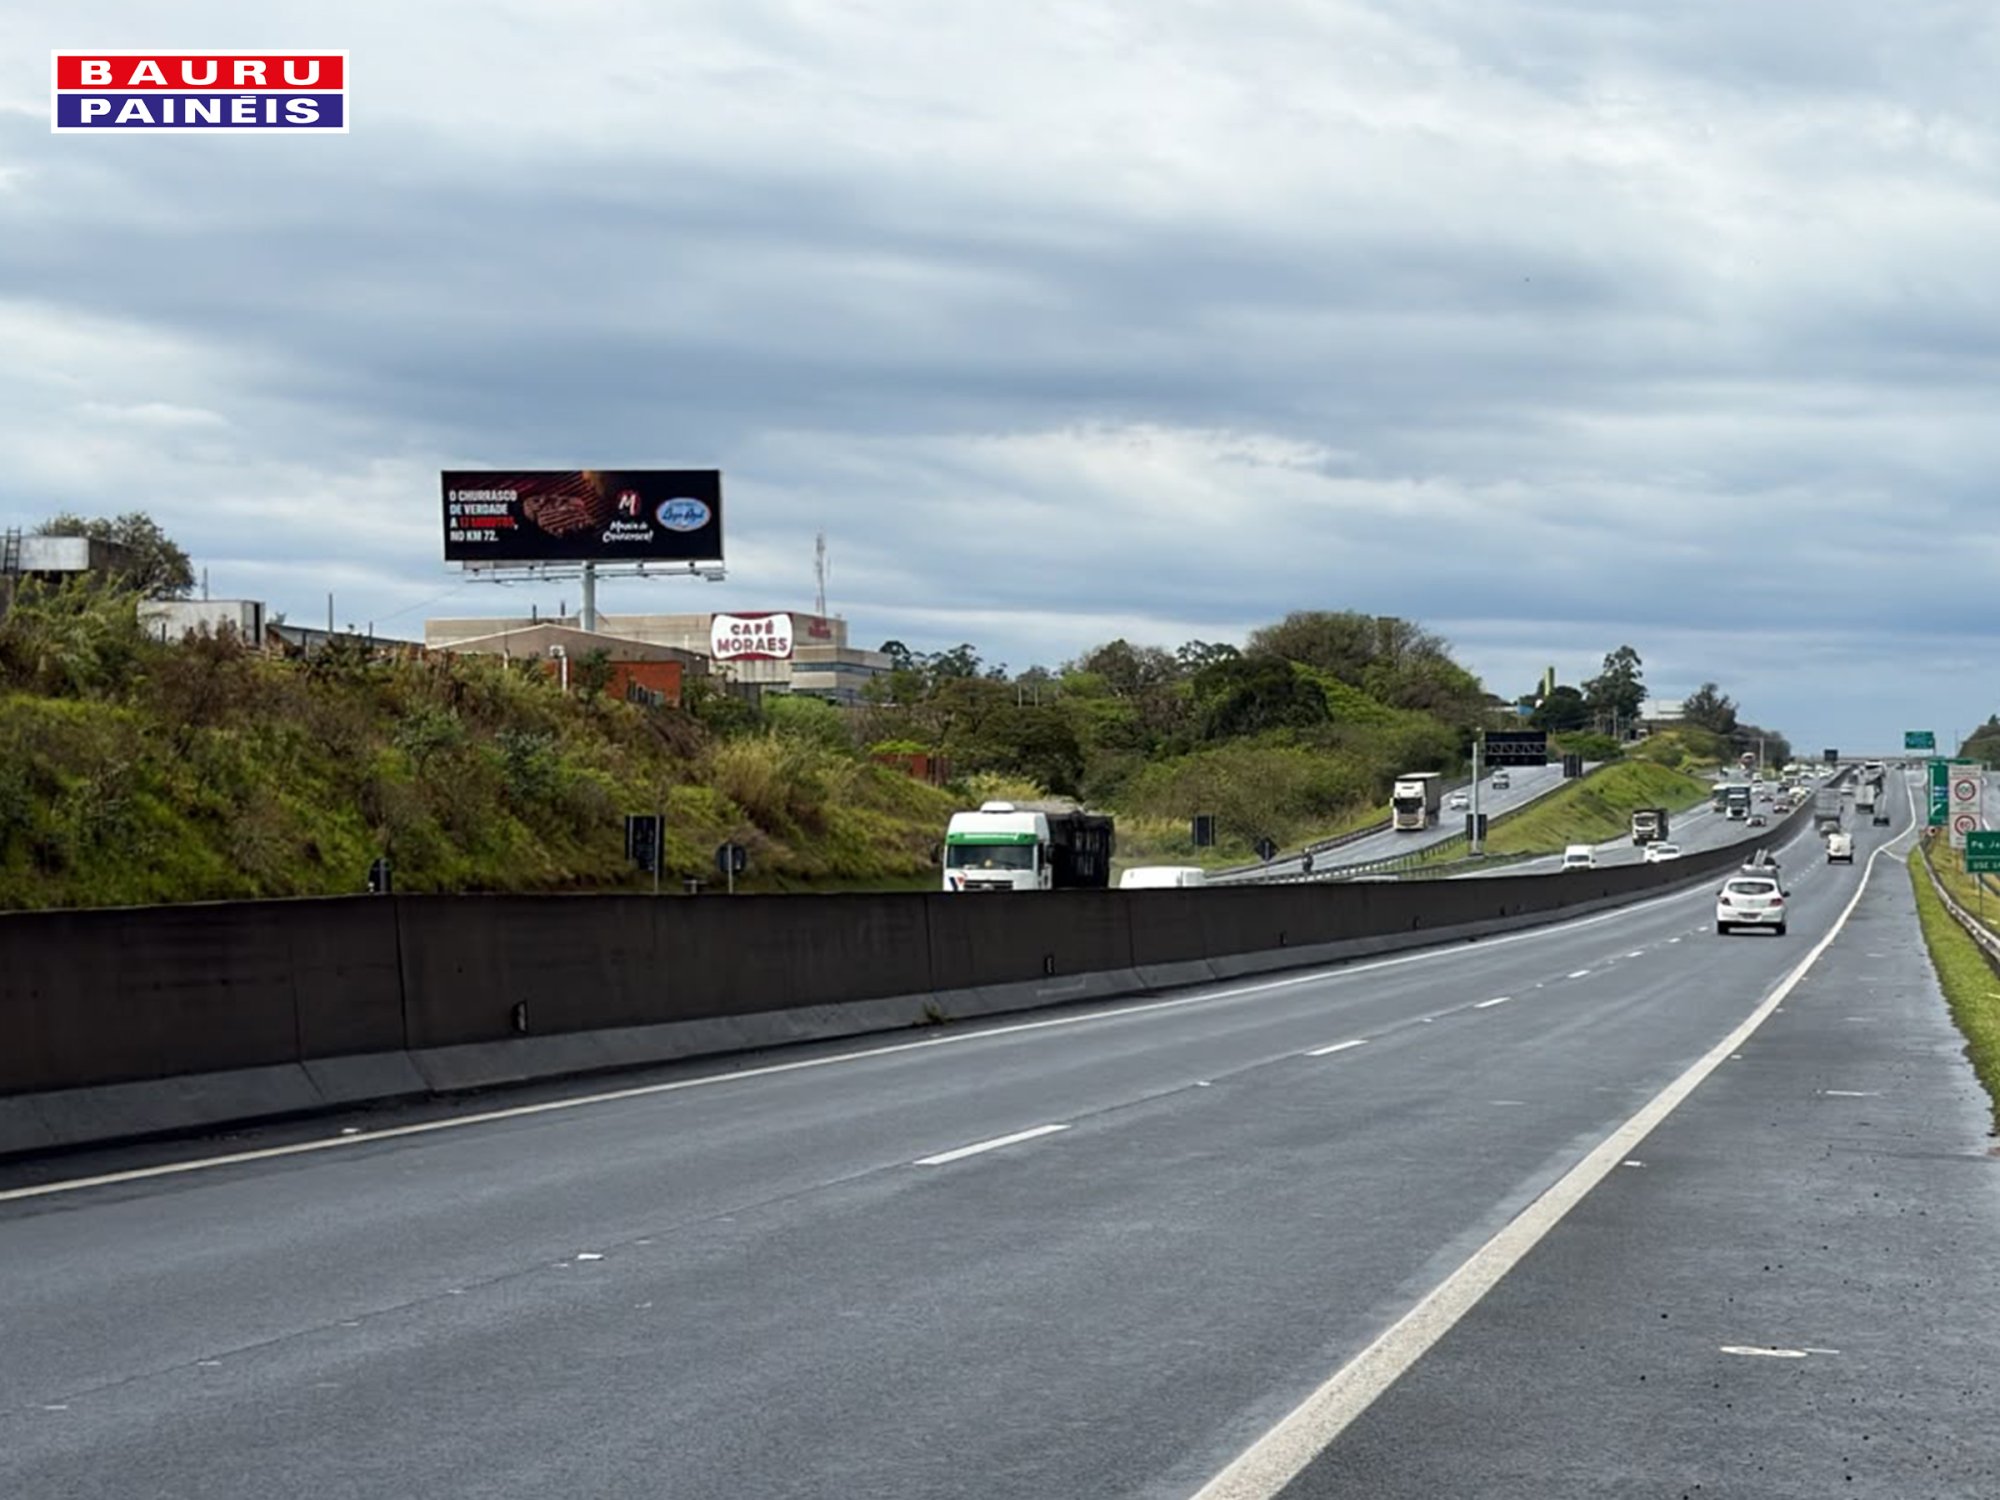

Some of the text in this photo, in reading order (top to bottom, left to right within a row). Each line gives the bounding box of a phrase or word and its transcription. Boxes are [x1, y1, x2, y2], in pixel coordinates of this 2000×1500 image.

[449, 490, 518, 502] O CHURRASCO
[449, 503, 509, 516] DE VERDADE
[450, 517, 458, 529] A
[449, 530, 465, 543] NO
[466, 530, 482, 542] KM
[730, 620, 775, 635] CAFÉ
[717, 637, 788, 653] MORAES
